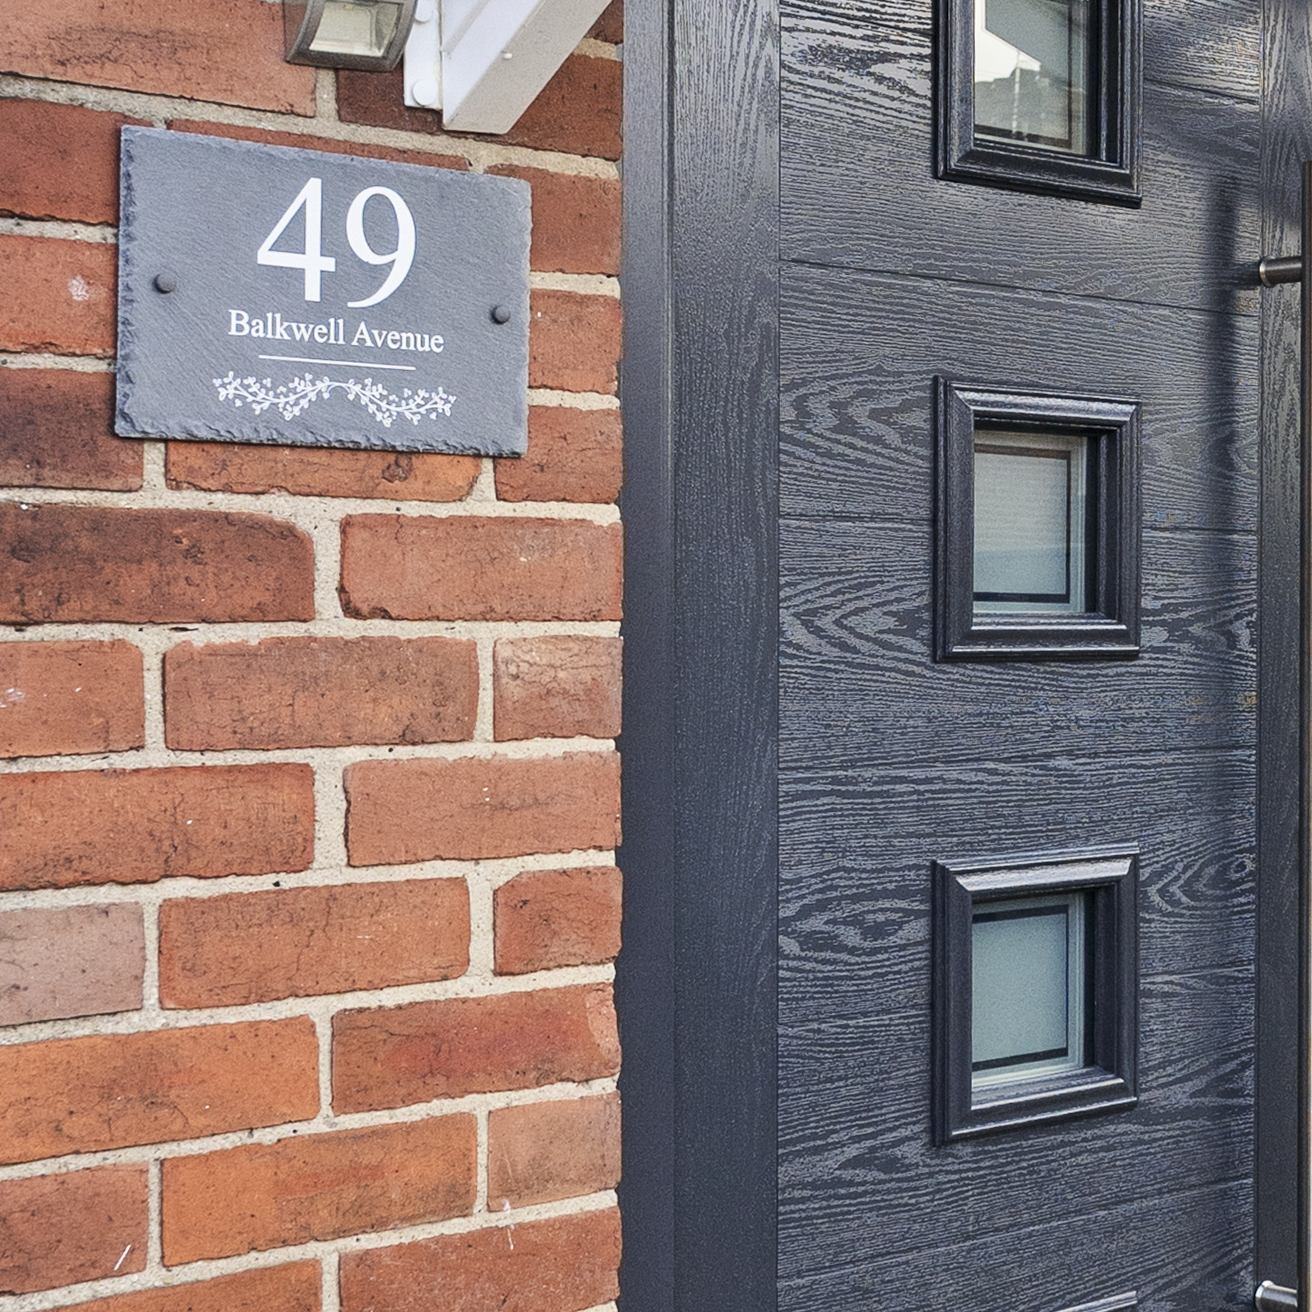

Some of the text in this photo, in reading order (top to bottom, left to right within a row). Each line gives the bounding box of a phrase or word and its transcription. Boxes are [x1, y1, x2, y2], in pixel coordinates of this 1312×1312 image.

[257, 177, 417, 308] 49
[228, 310, 445, 353] Balkwell Avenue
